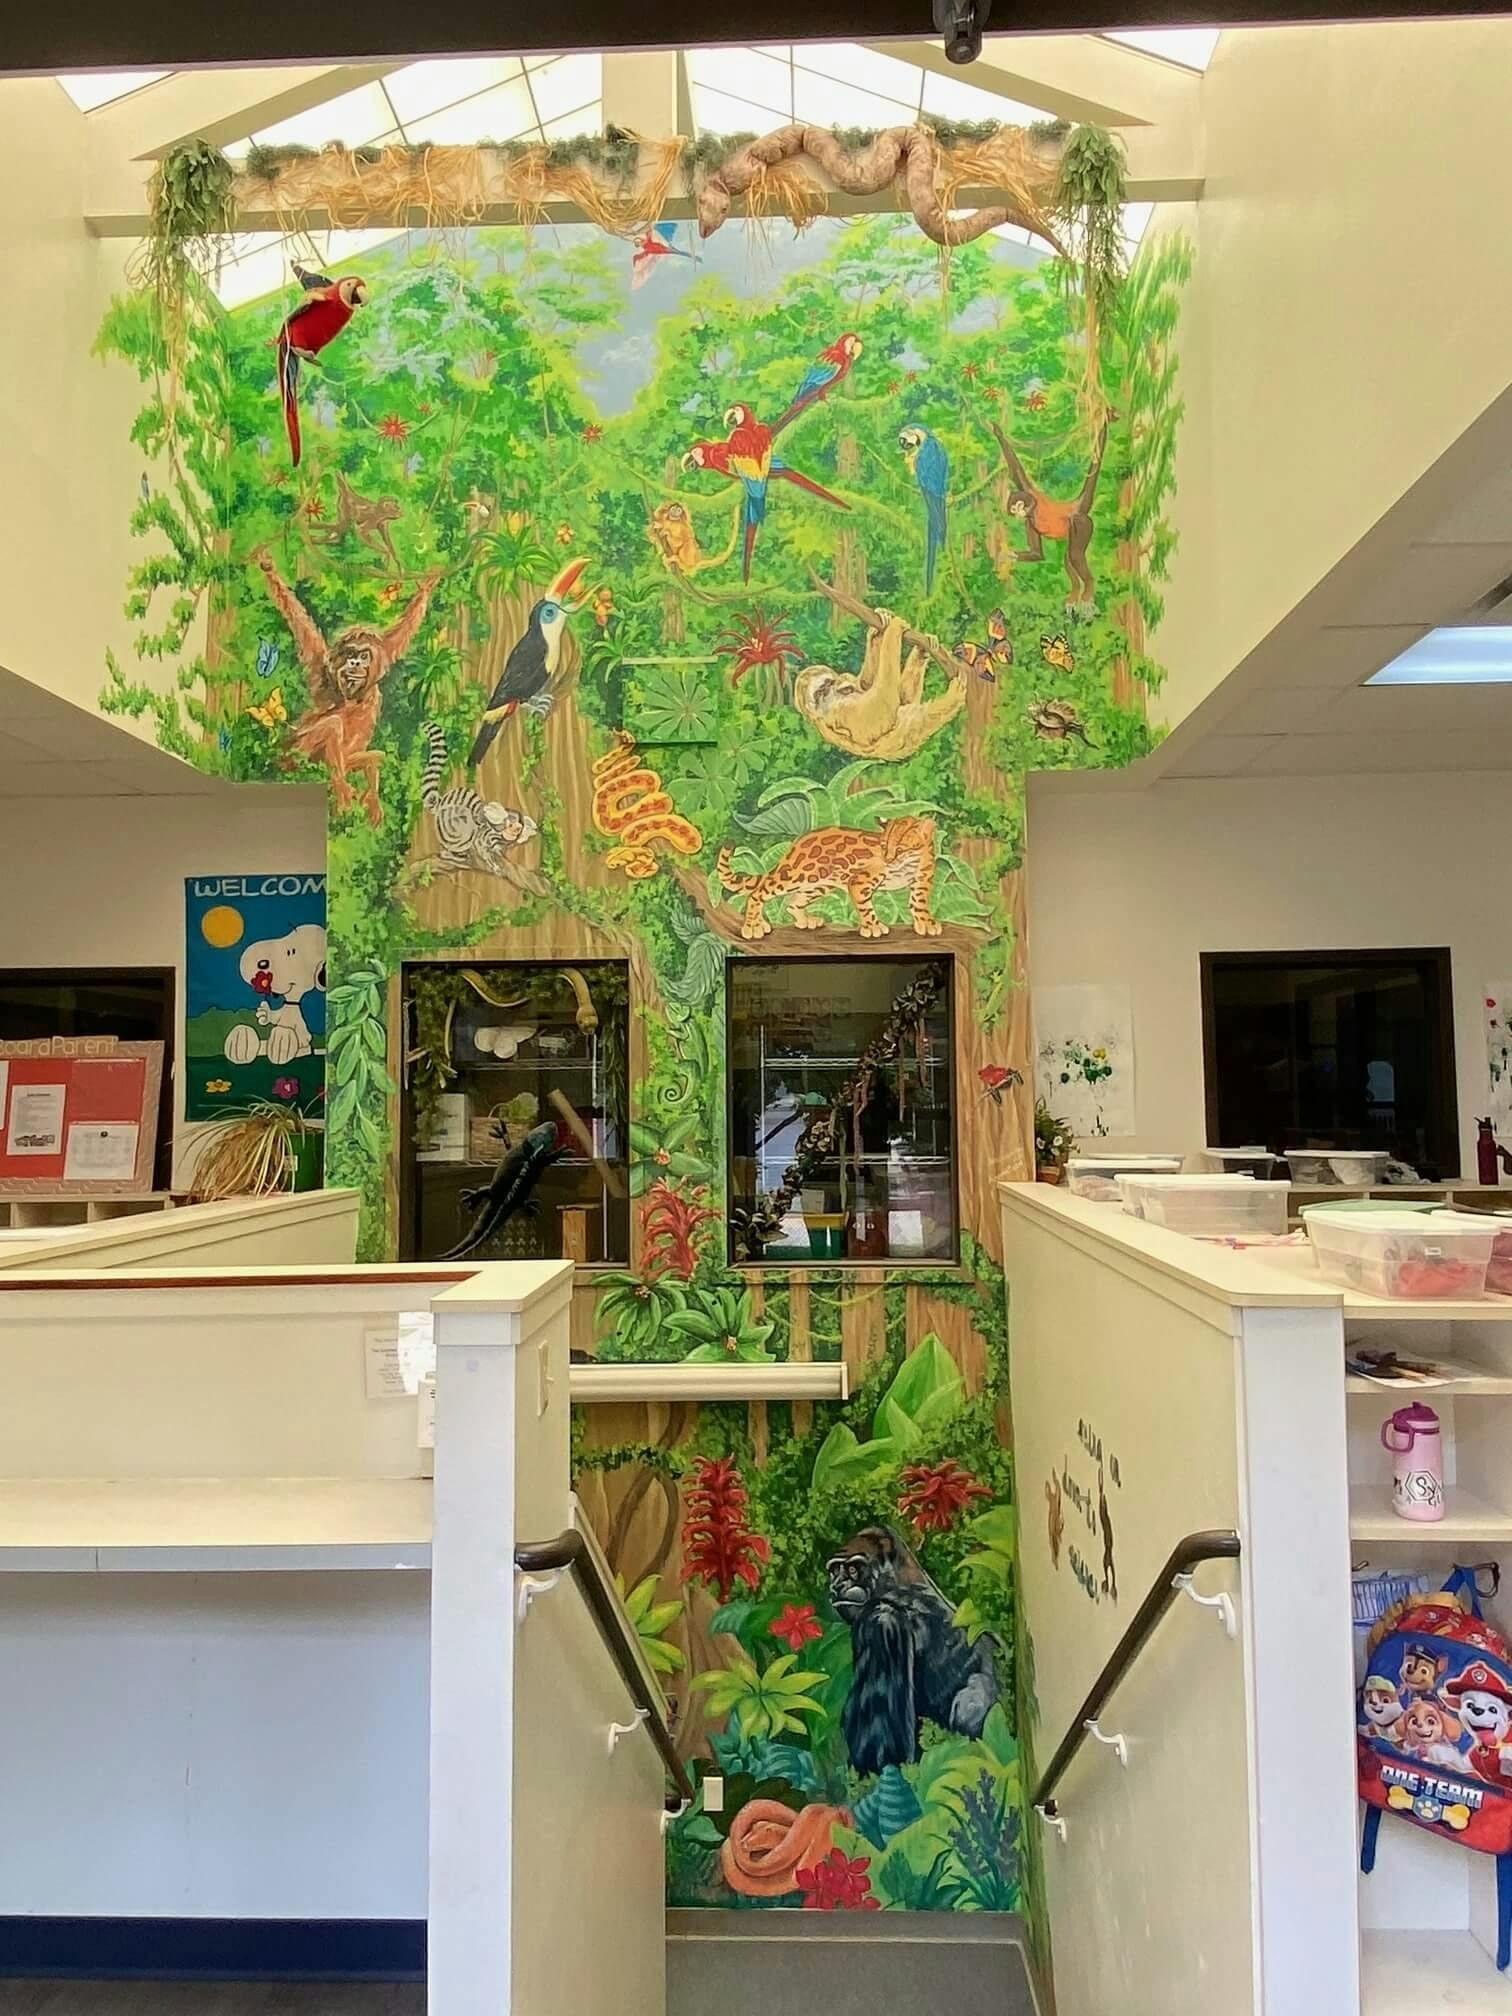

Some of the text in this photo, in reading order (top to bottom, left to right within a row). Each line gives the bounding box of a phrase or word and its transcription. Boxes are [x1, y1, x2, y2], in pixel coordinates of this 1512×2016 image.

[194, 876, 327, 897] WELCOM
[0, 1038, 51, 1056] oard
[1423, 1776, 1484, 1809] TEAM
